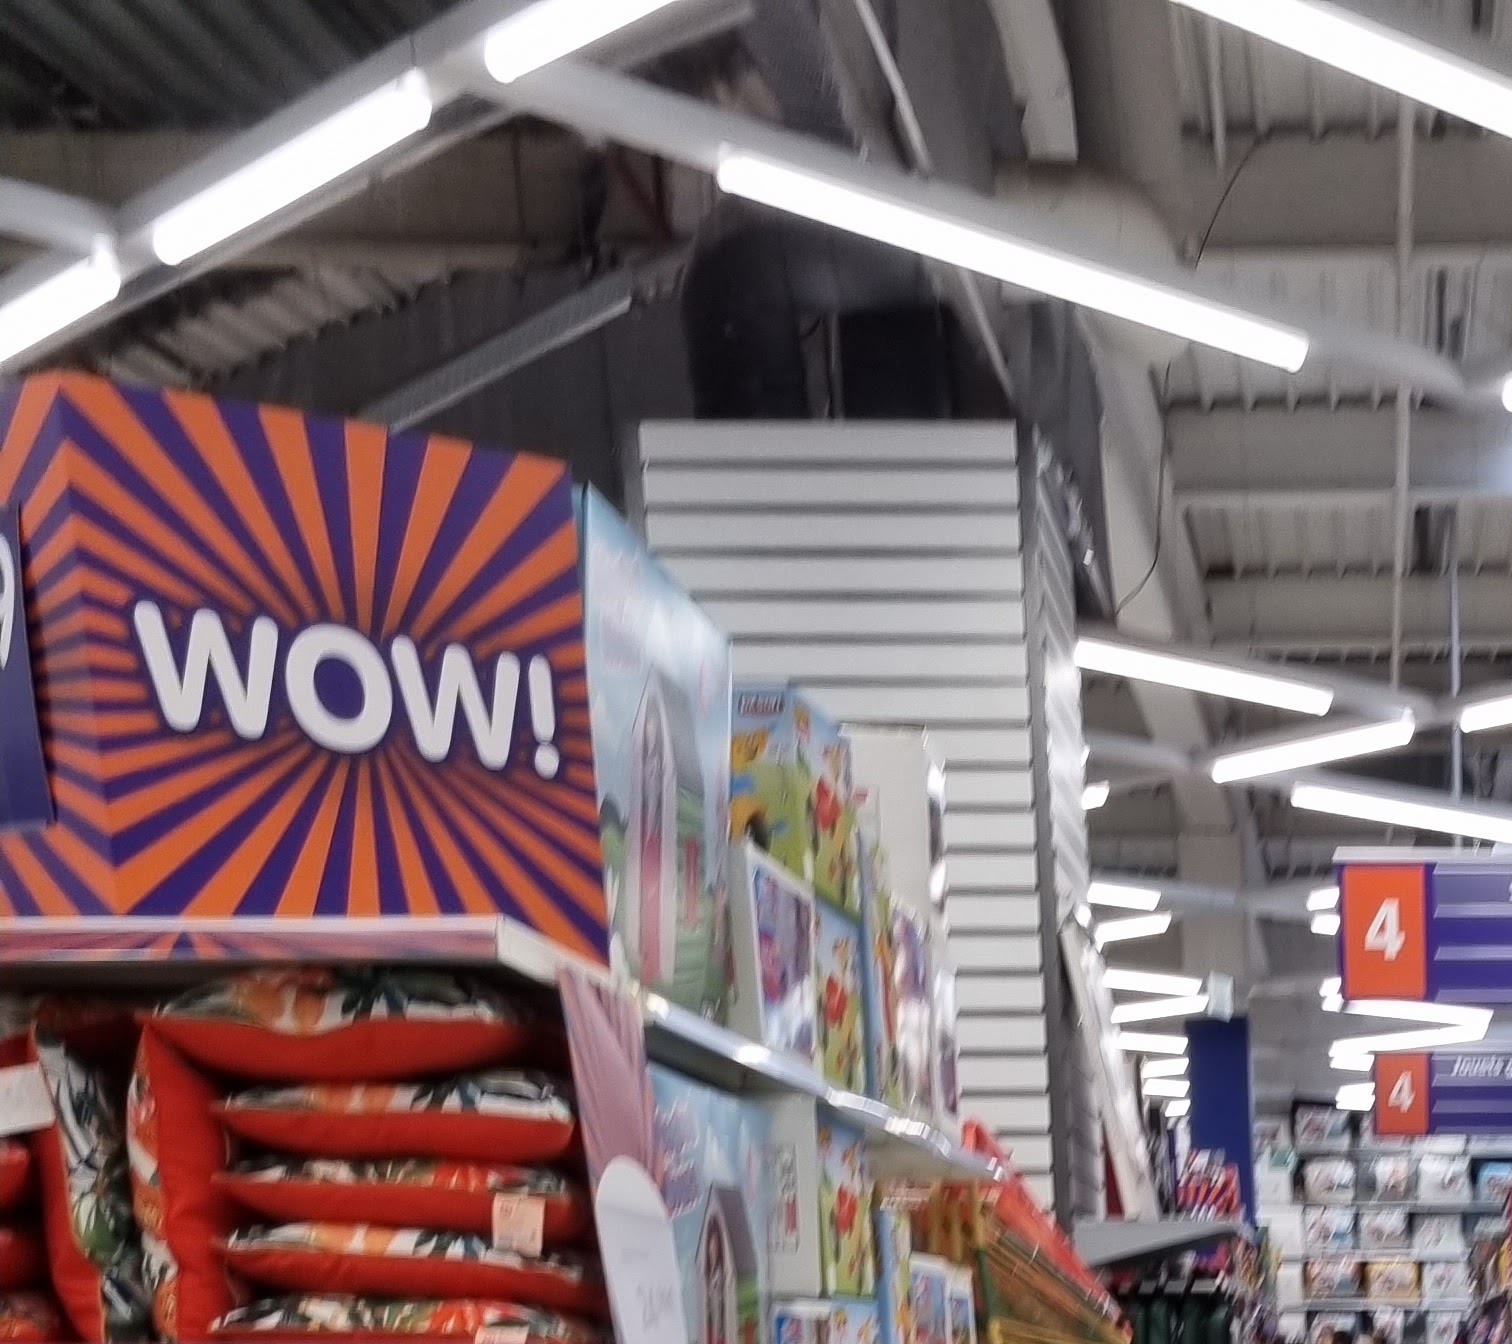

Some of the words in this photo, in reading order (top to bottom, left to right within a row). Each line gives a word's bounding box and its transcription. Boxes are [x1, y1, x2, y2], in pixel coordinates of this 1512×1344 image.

[134, 599, 560, 780] WOW!
[1364, 897, 1406, 962] 4
[1388, 1069, 1417, 1115] 4
